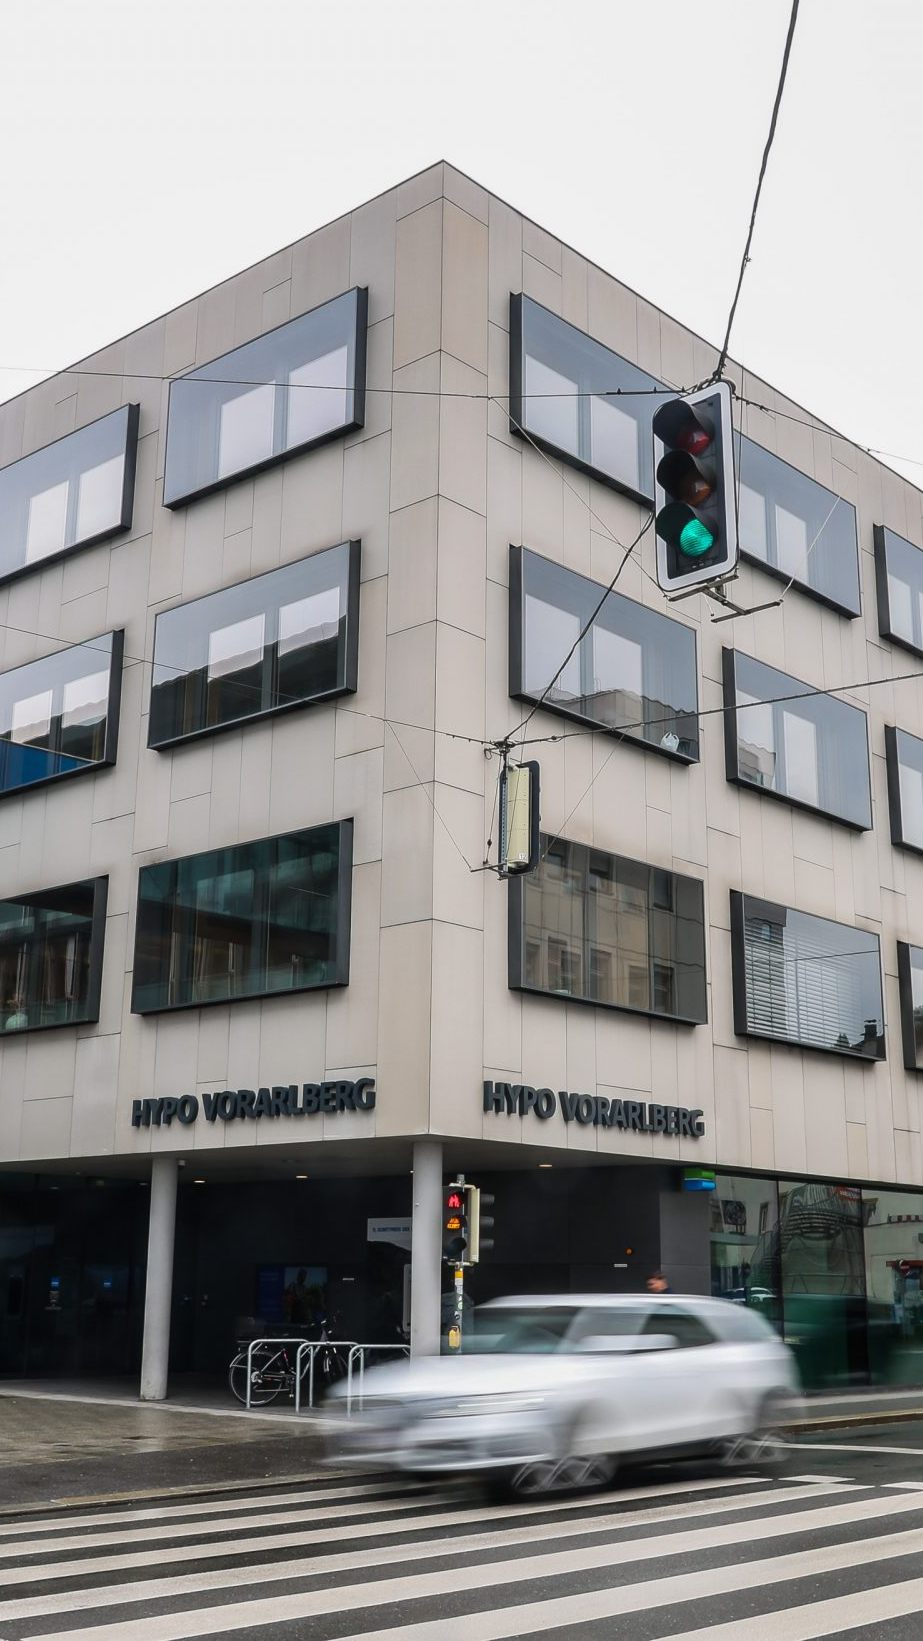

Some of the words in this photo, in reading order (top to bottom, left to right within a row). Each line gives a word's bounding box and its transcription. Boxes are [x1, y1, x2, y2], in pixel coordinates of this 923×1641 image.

[132, 1095, 198, 1126] HYPO
[202, 1078, 376, 1121] VORARLBERG
[483, 1080, 556, 1119] HYPO
[558, 1091, 705, 1137] VORARLBERG
